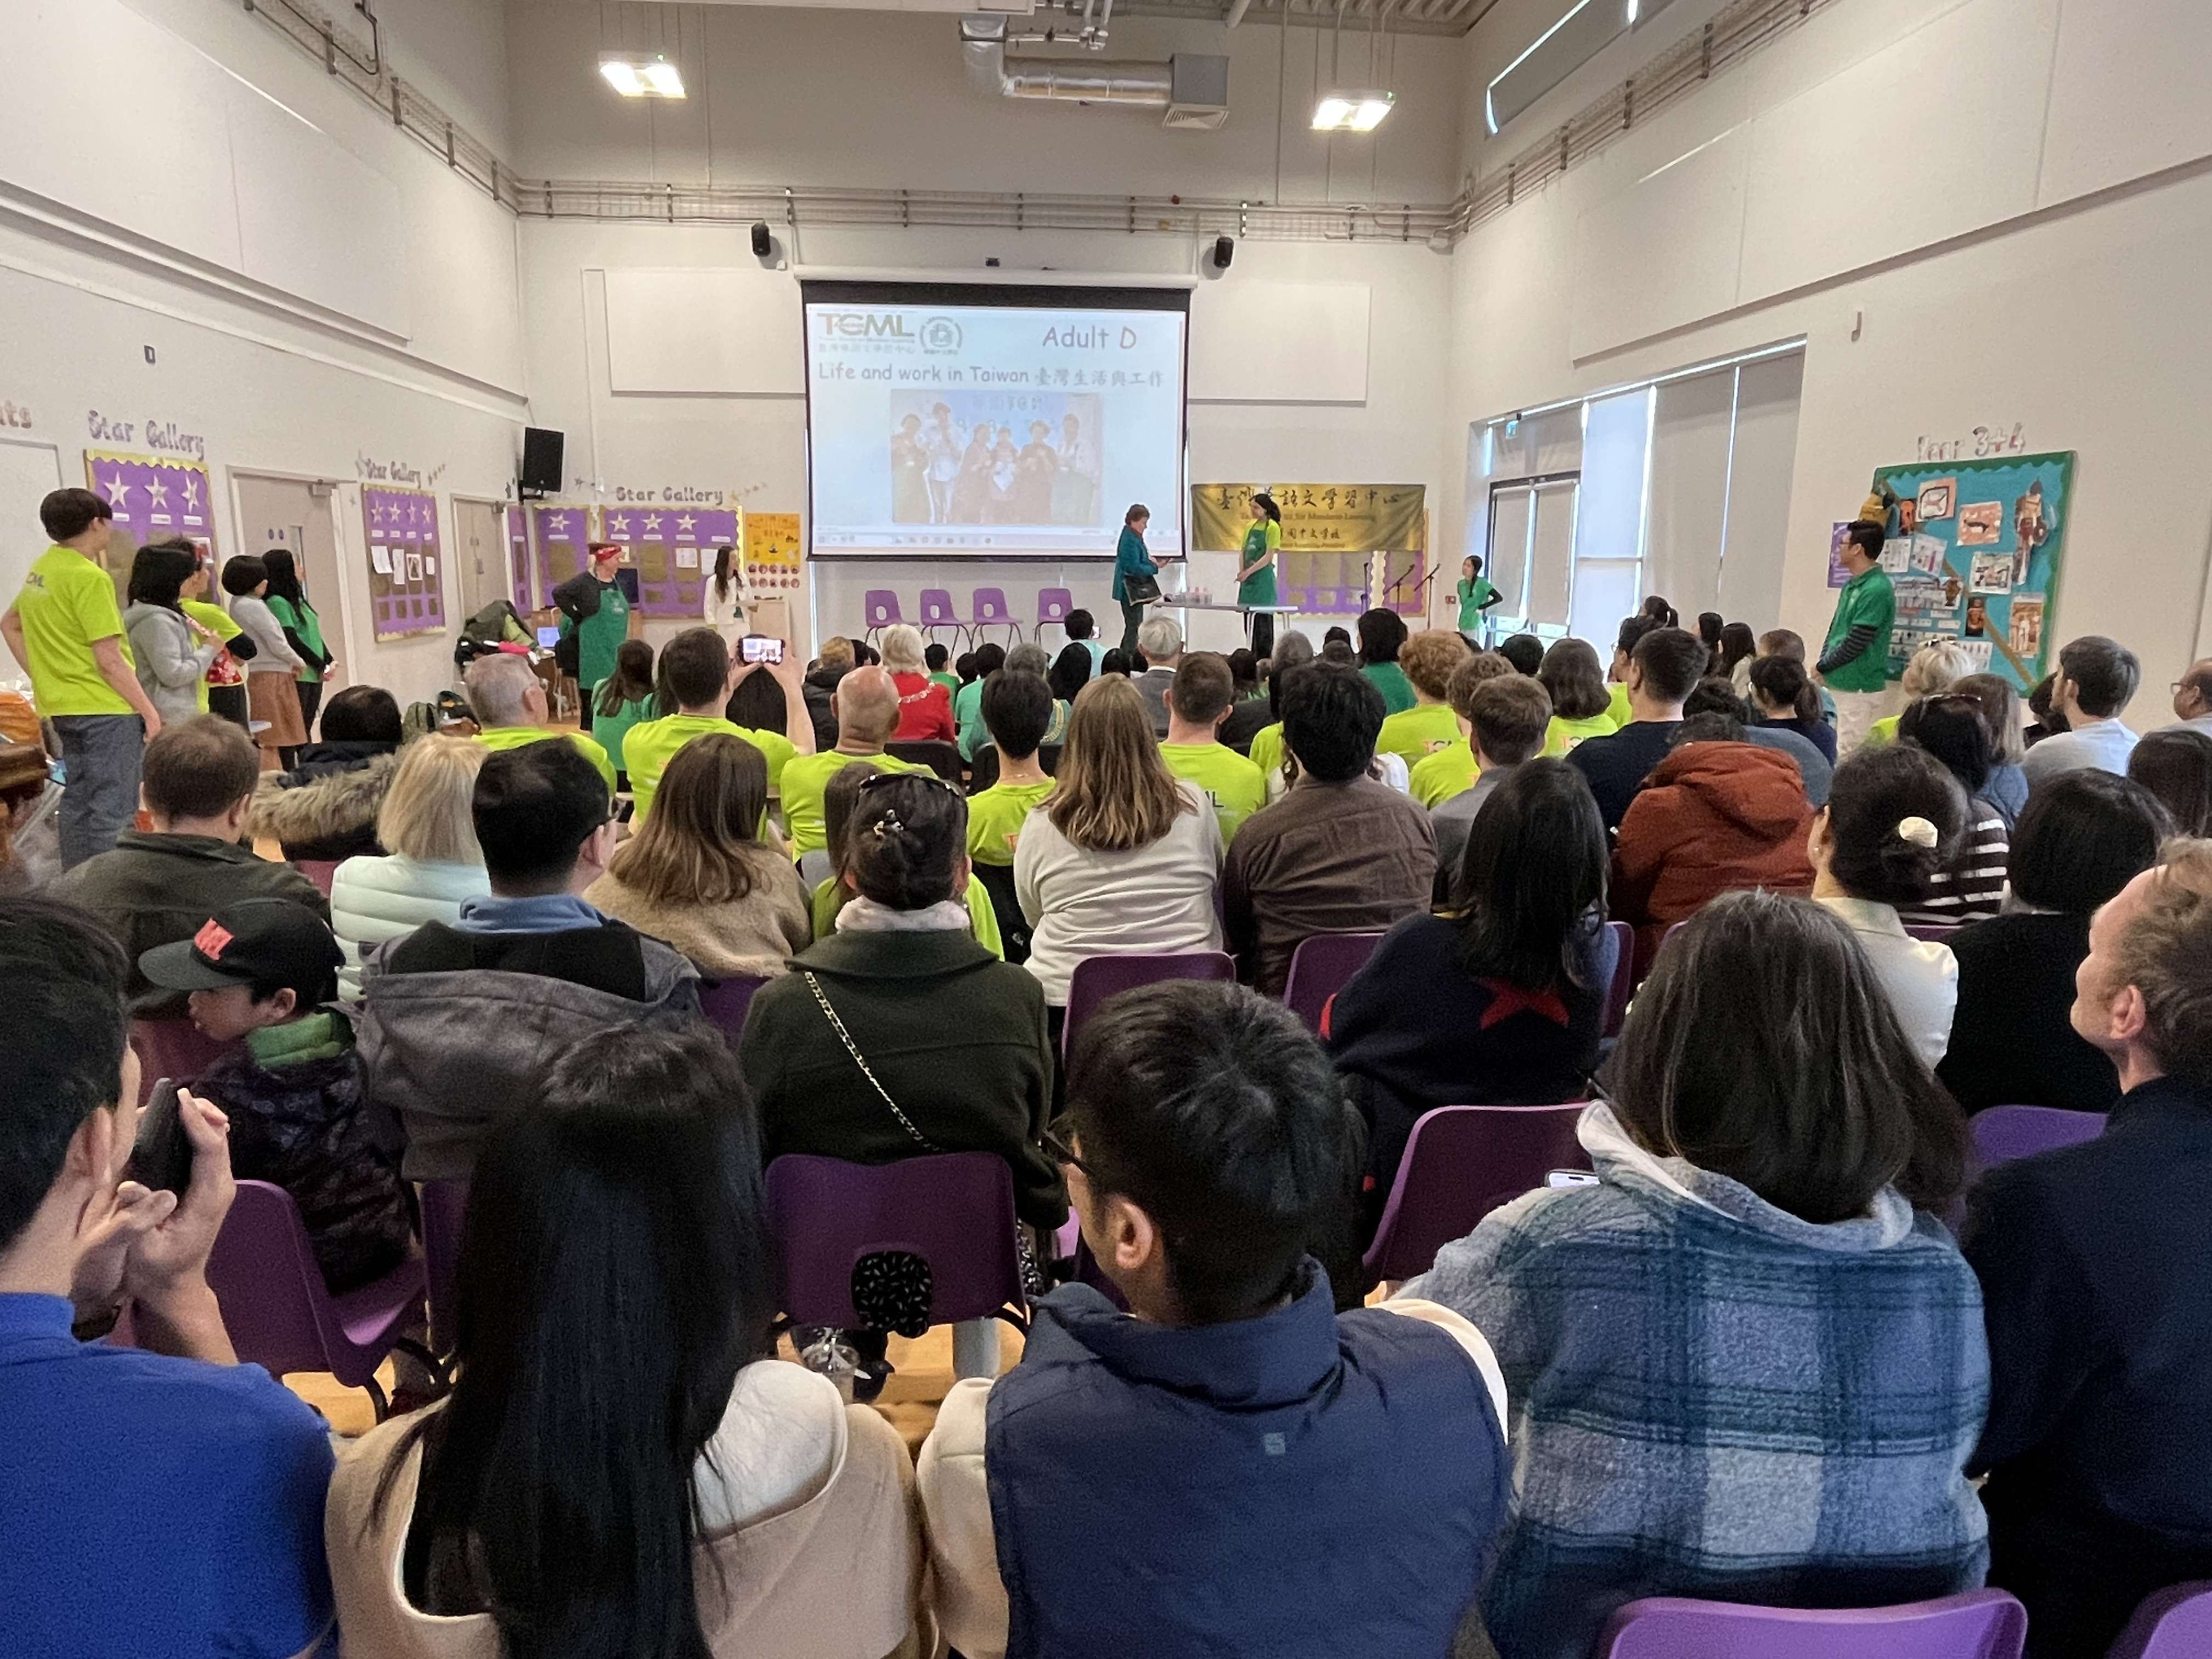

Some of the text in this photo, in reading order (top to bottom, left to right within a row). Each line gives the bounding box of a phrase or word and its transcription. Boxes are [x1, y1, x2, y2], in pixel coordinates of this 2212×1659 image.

[1042, 325, 1137, 349] Adult D
[819, 362, 856, 380] Life
[861, 363, 892, 380] and
[899, 365, 941, 381] work
[948, 366, 962, 381] in
[969, 366, 1029, 383] Taiwan
[88, 409, 205, 462] Star Gallery
[616, 486, 724, 506] Star Gallery
